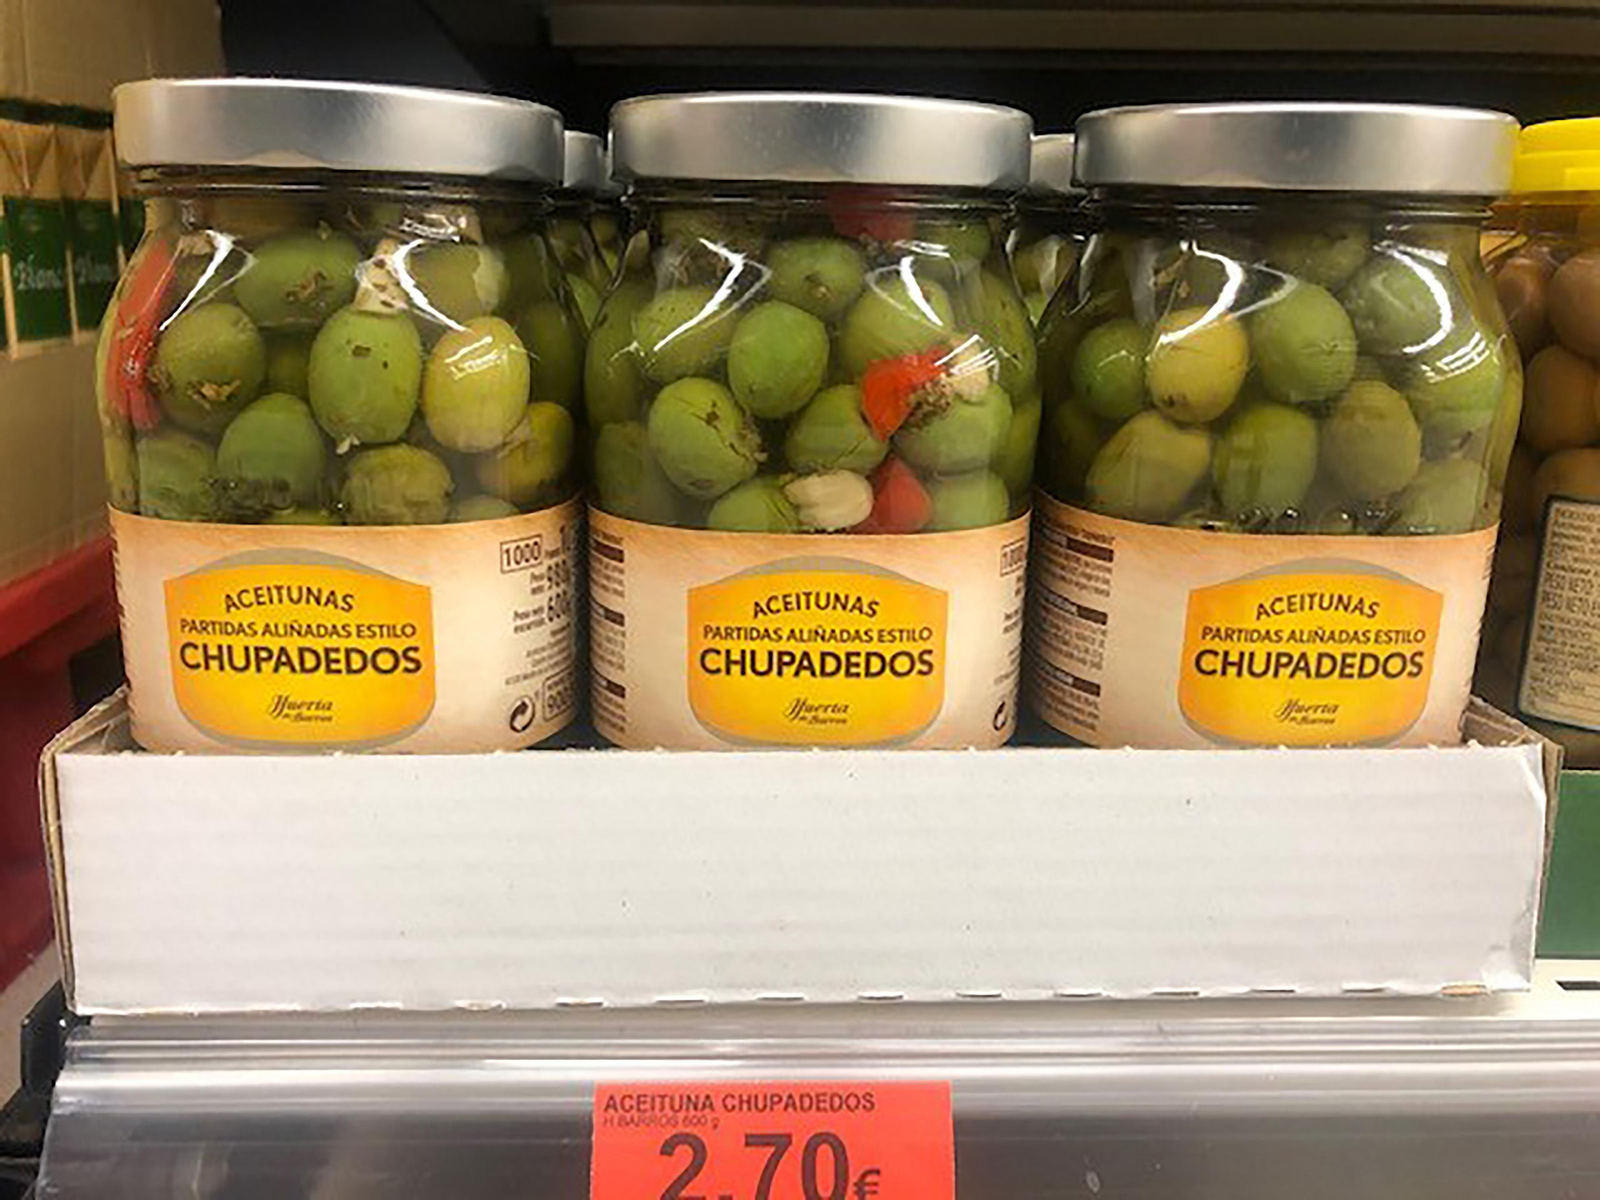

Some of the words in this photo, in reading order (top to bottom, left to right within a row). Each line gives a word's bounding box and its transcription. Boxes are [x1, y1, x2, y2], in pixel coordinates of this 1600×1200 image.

[504, 541, 541, 567] 1000
[223, 584, 355, 614] ACEITUNAS
[752, 591, 880, 619] ACEITUNAS
[1255, 592, 1381, 621] ACEITUNAS
[180, 618, 258, 637] PARTIDAS
[262, 618, 352, 638] ALIÑADAS
[355, 622, 416, 639] ESTILO
[703, 625, 783, 643] PARTIDAS
[786, 624, 874, 644] ALIÑADAS
[877, 626, 933, 644] ESTILO
[1201, 626, 1284, 643] PARTIDAS
[1287, 625, 1371, 644] ALIÑADAS
[1374, 628, 1426, 645] ESTILO
[180, 642, 422, 675] CHUPADEDOS
[700, 648, 934, 678] CHUPADEDOS
[1195, 650, 1424, 679] CHUPADEDOS
[604, 1093, 714, 1113] ACEITUNA
[721, 1092, 876, 1113] CHUPADEDOS
[617, 1115, 679, 1128] BARROS
[681, 1115, 708, 1128] 600
